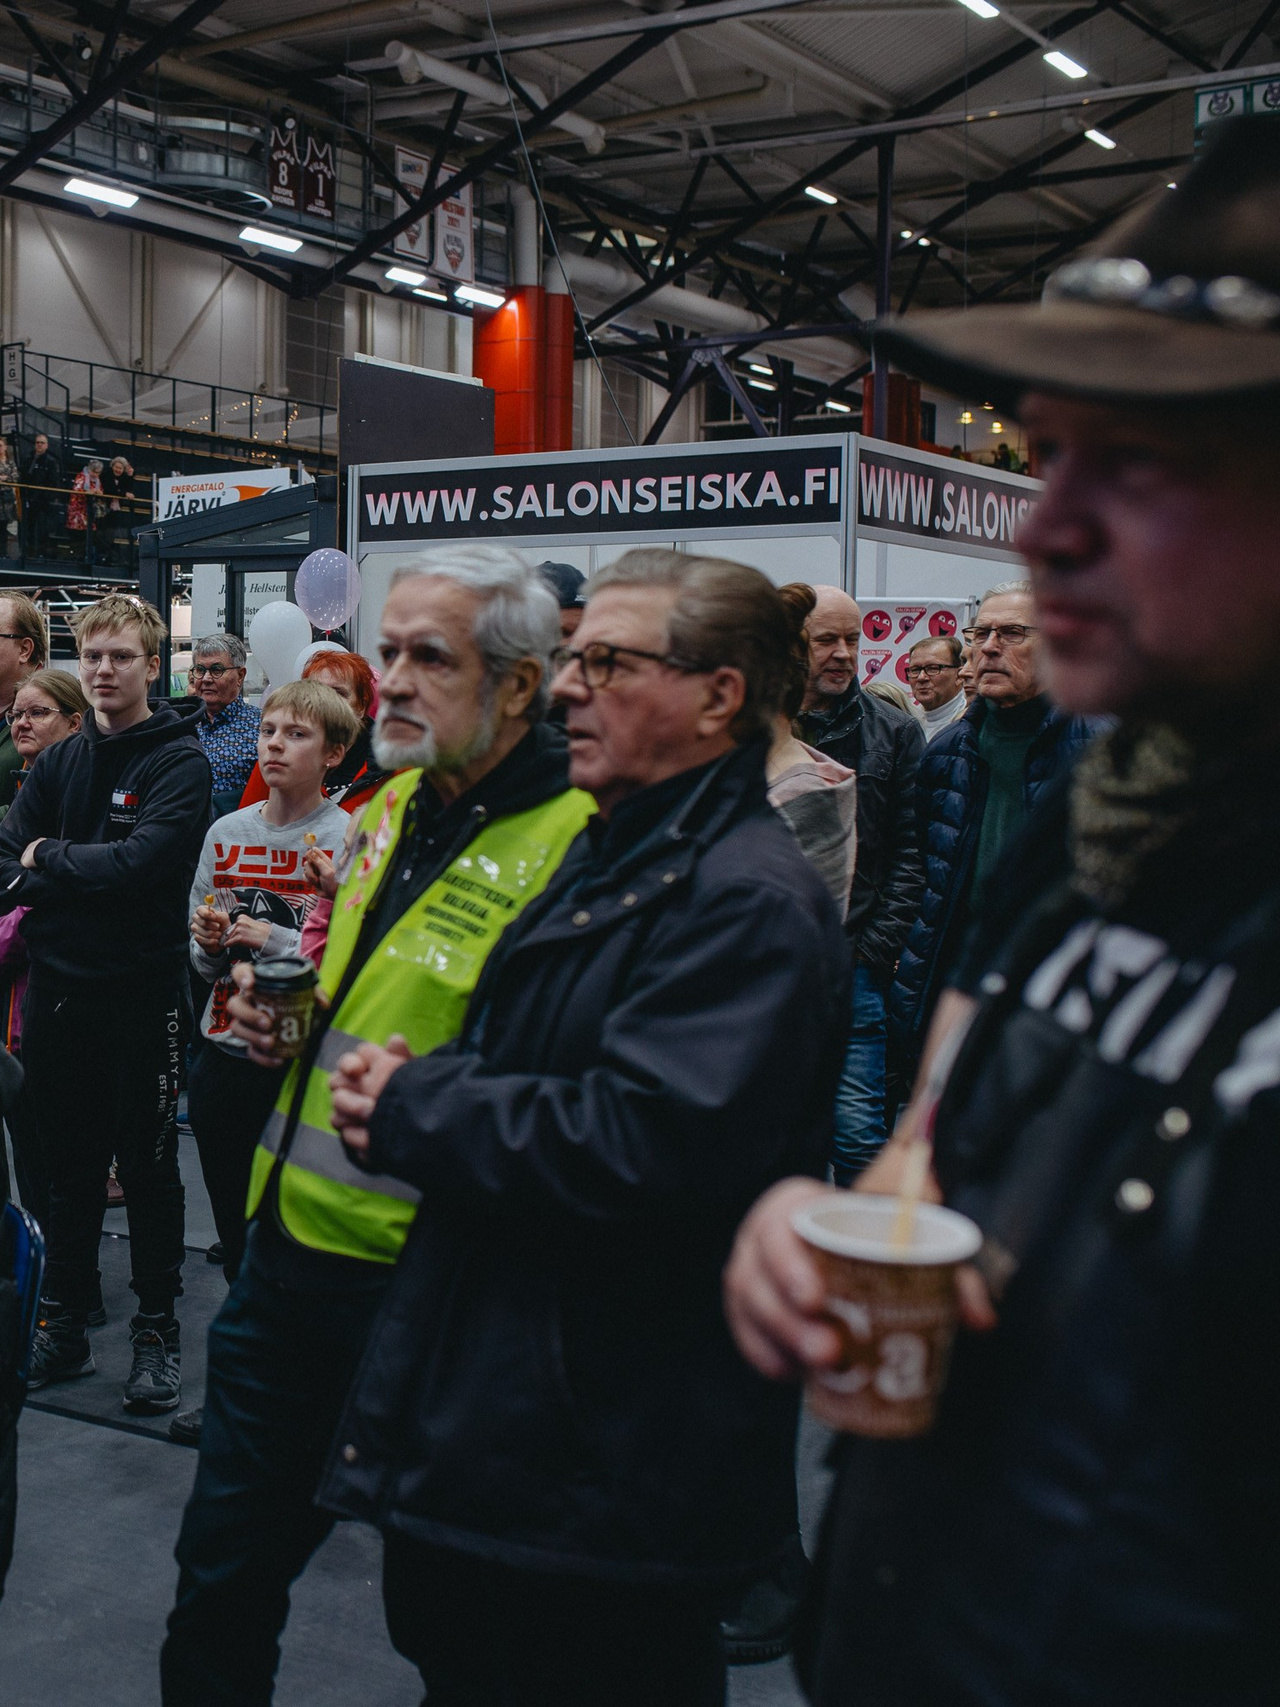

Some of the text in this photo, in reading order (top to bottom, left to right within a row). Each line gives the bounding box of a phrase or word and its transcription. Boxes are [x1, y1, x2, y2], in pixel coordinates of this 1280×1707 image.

[278, 161, 289, 187] 8
[317, 172, 324, 198] 1
[171, 482, 225, 494] ENERGIATALO
[366, 467, 839, 526] WWW.SALONSEISKA.FI
[164, 495, 222, 519] JÄRVI
[860, 462, 1039, 543] WWW.SALONS
[167, 1008, 179, 1075] TOMMY
[158, 1074, 168, 1093] EST.
